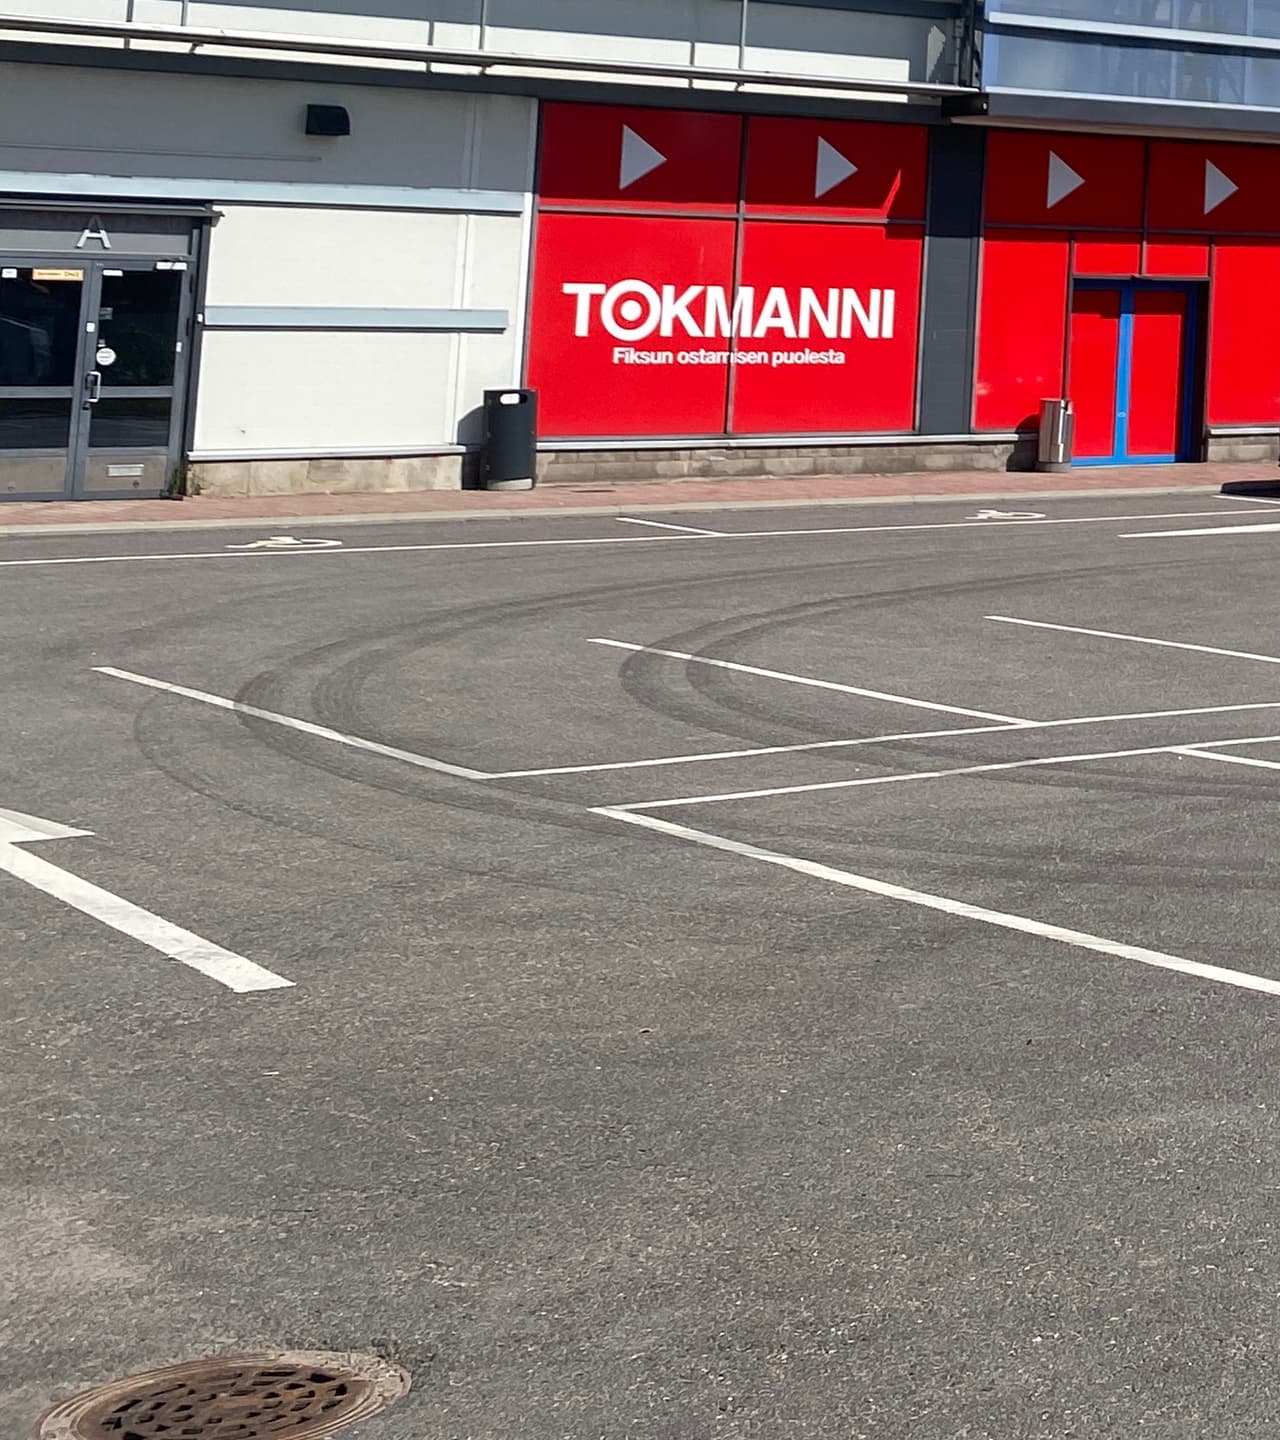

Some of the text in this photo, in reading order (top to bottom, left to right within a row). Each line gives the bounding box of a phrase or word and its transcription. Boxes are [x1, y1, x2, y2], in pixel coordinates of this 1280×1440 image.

[75, 216, 112, 249] A
[562, 279, 896, 342] TOKMANNI
[612, 346, 846, 367] Fiksun ostamisen puolesta
